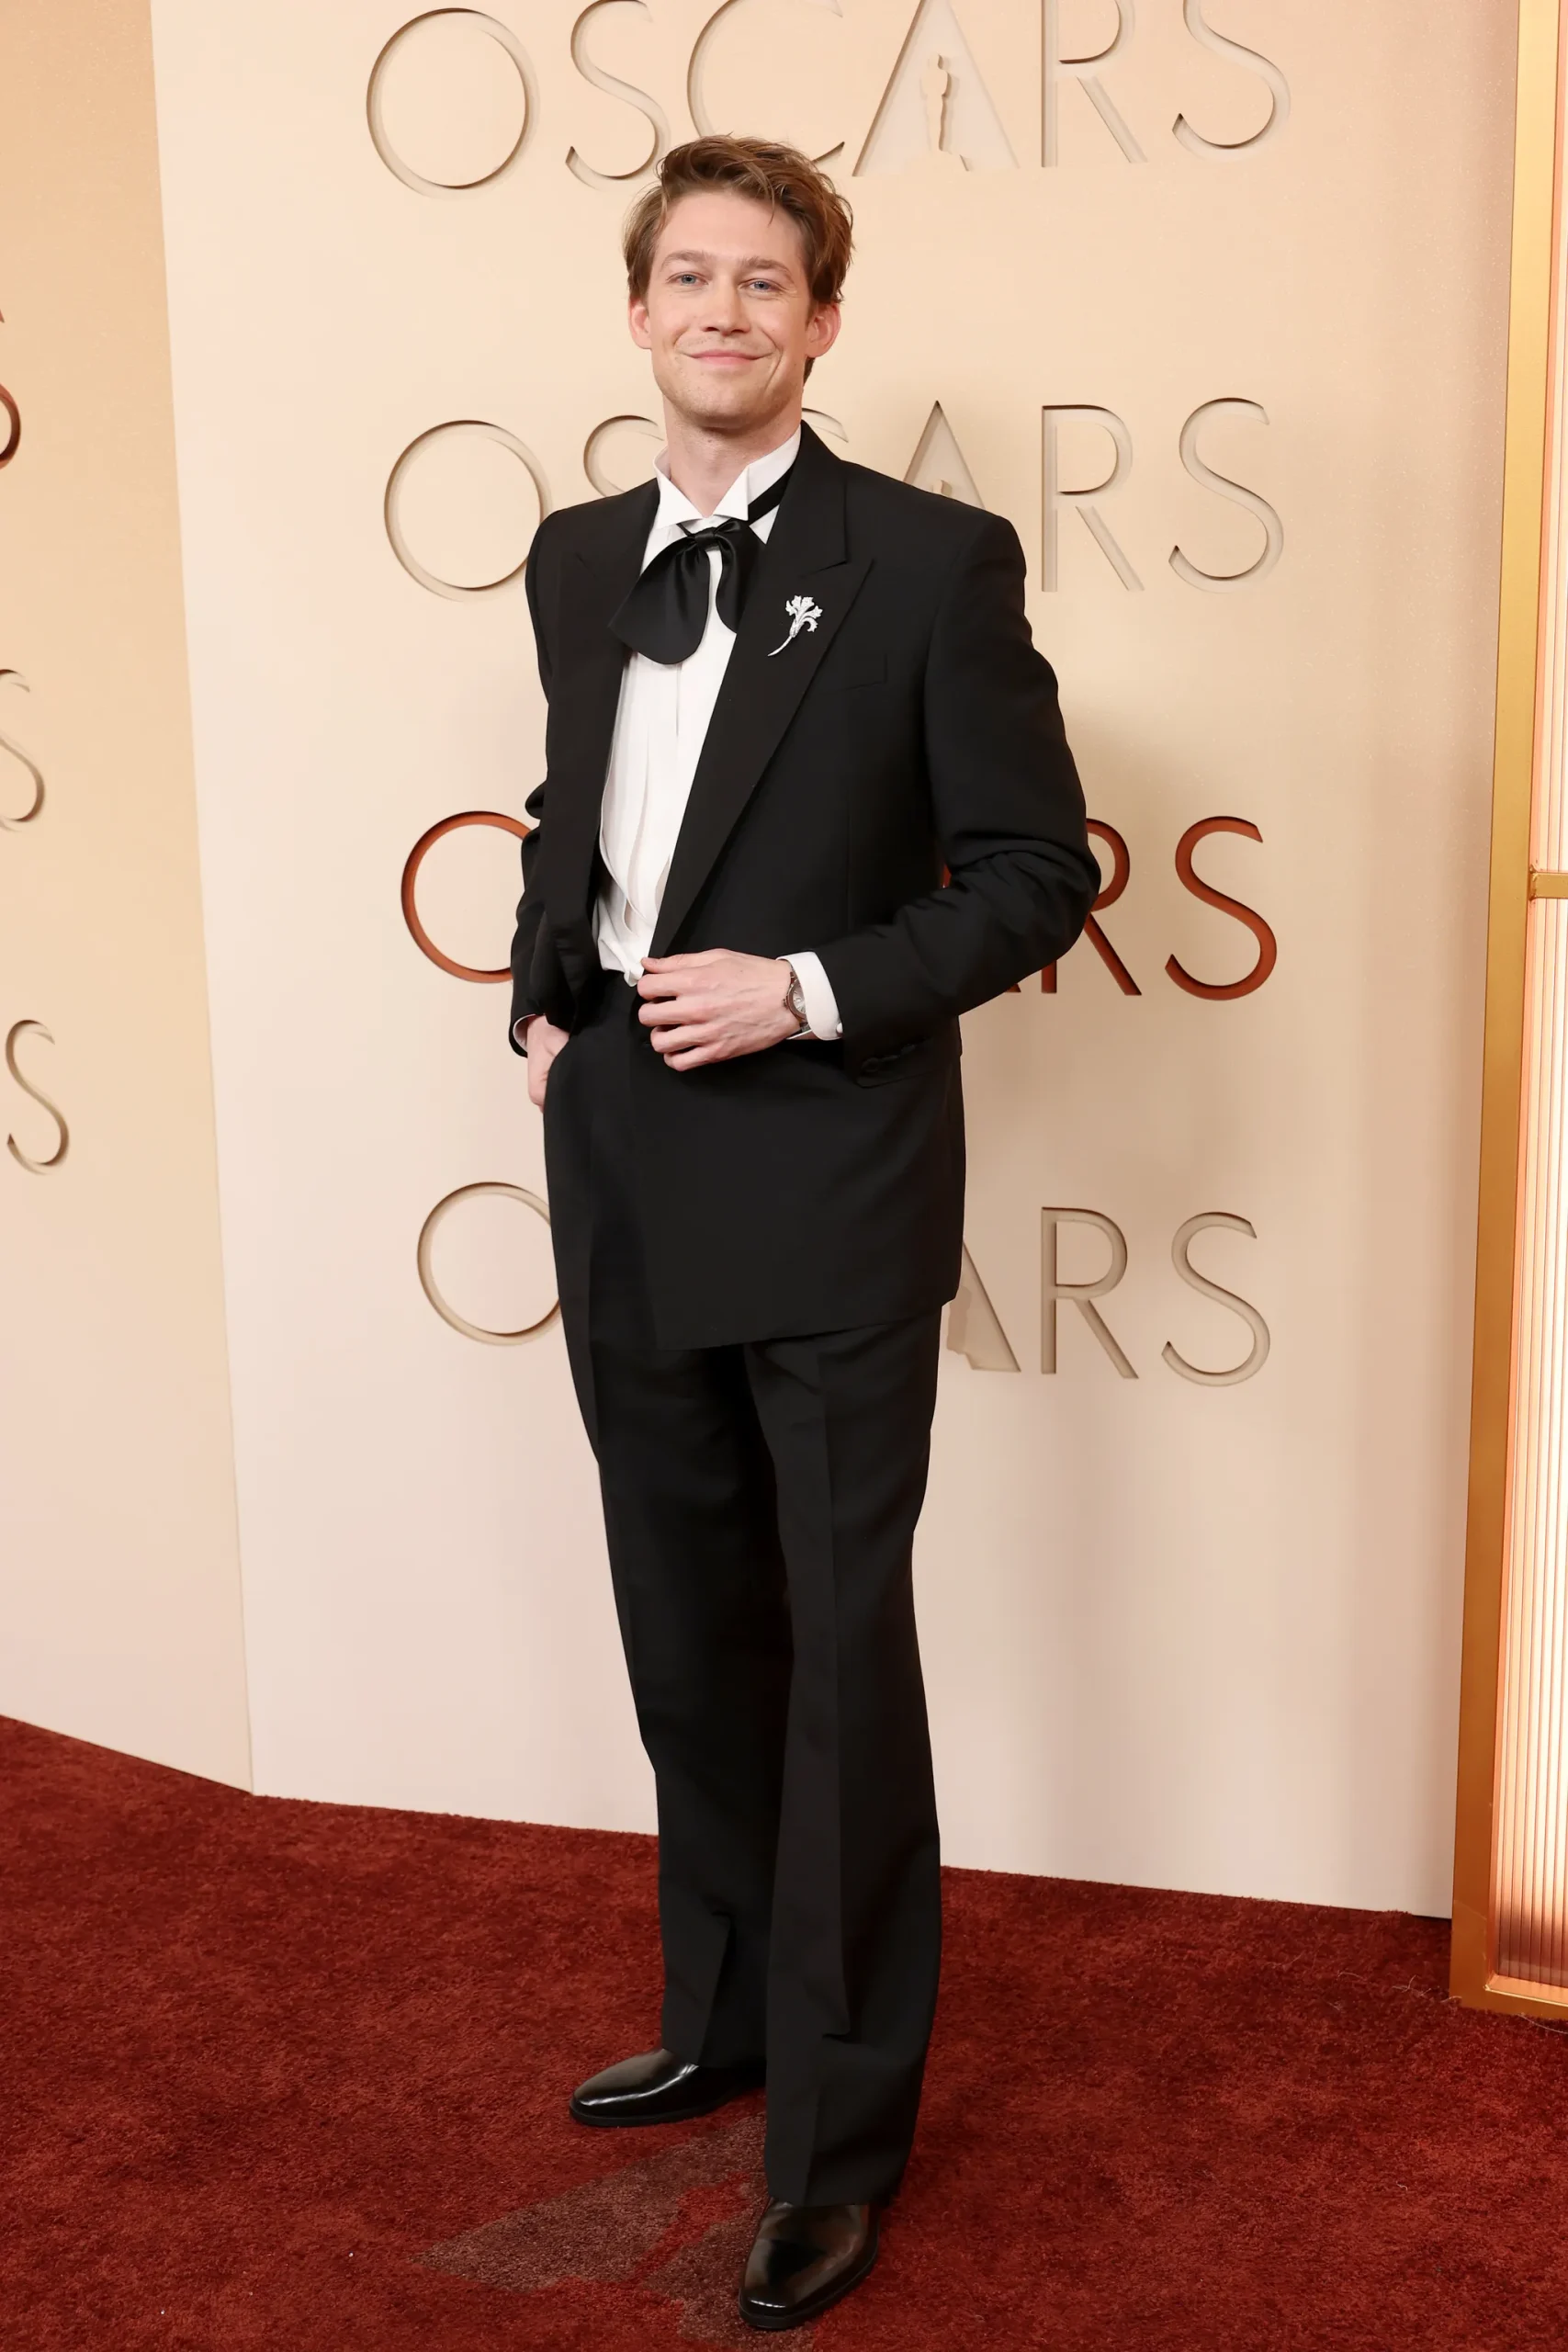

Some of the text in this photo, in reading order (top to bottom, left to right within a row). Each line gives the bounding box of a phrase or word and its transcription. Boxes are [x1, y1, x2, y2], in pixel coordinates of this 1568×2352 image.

[366, 0, 1291, 197] OSCARS
[383, 397, 1285, 603] ORS
[400, 810, 1278, 1001] ORS
[416, 1181, 1271, 1387] ORS
